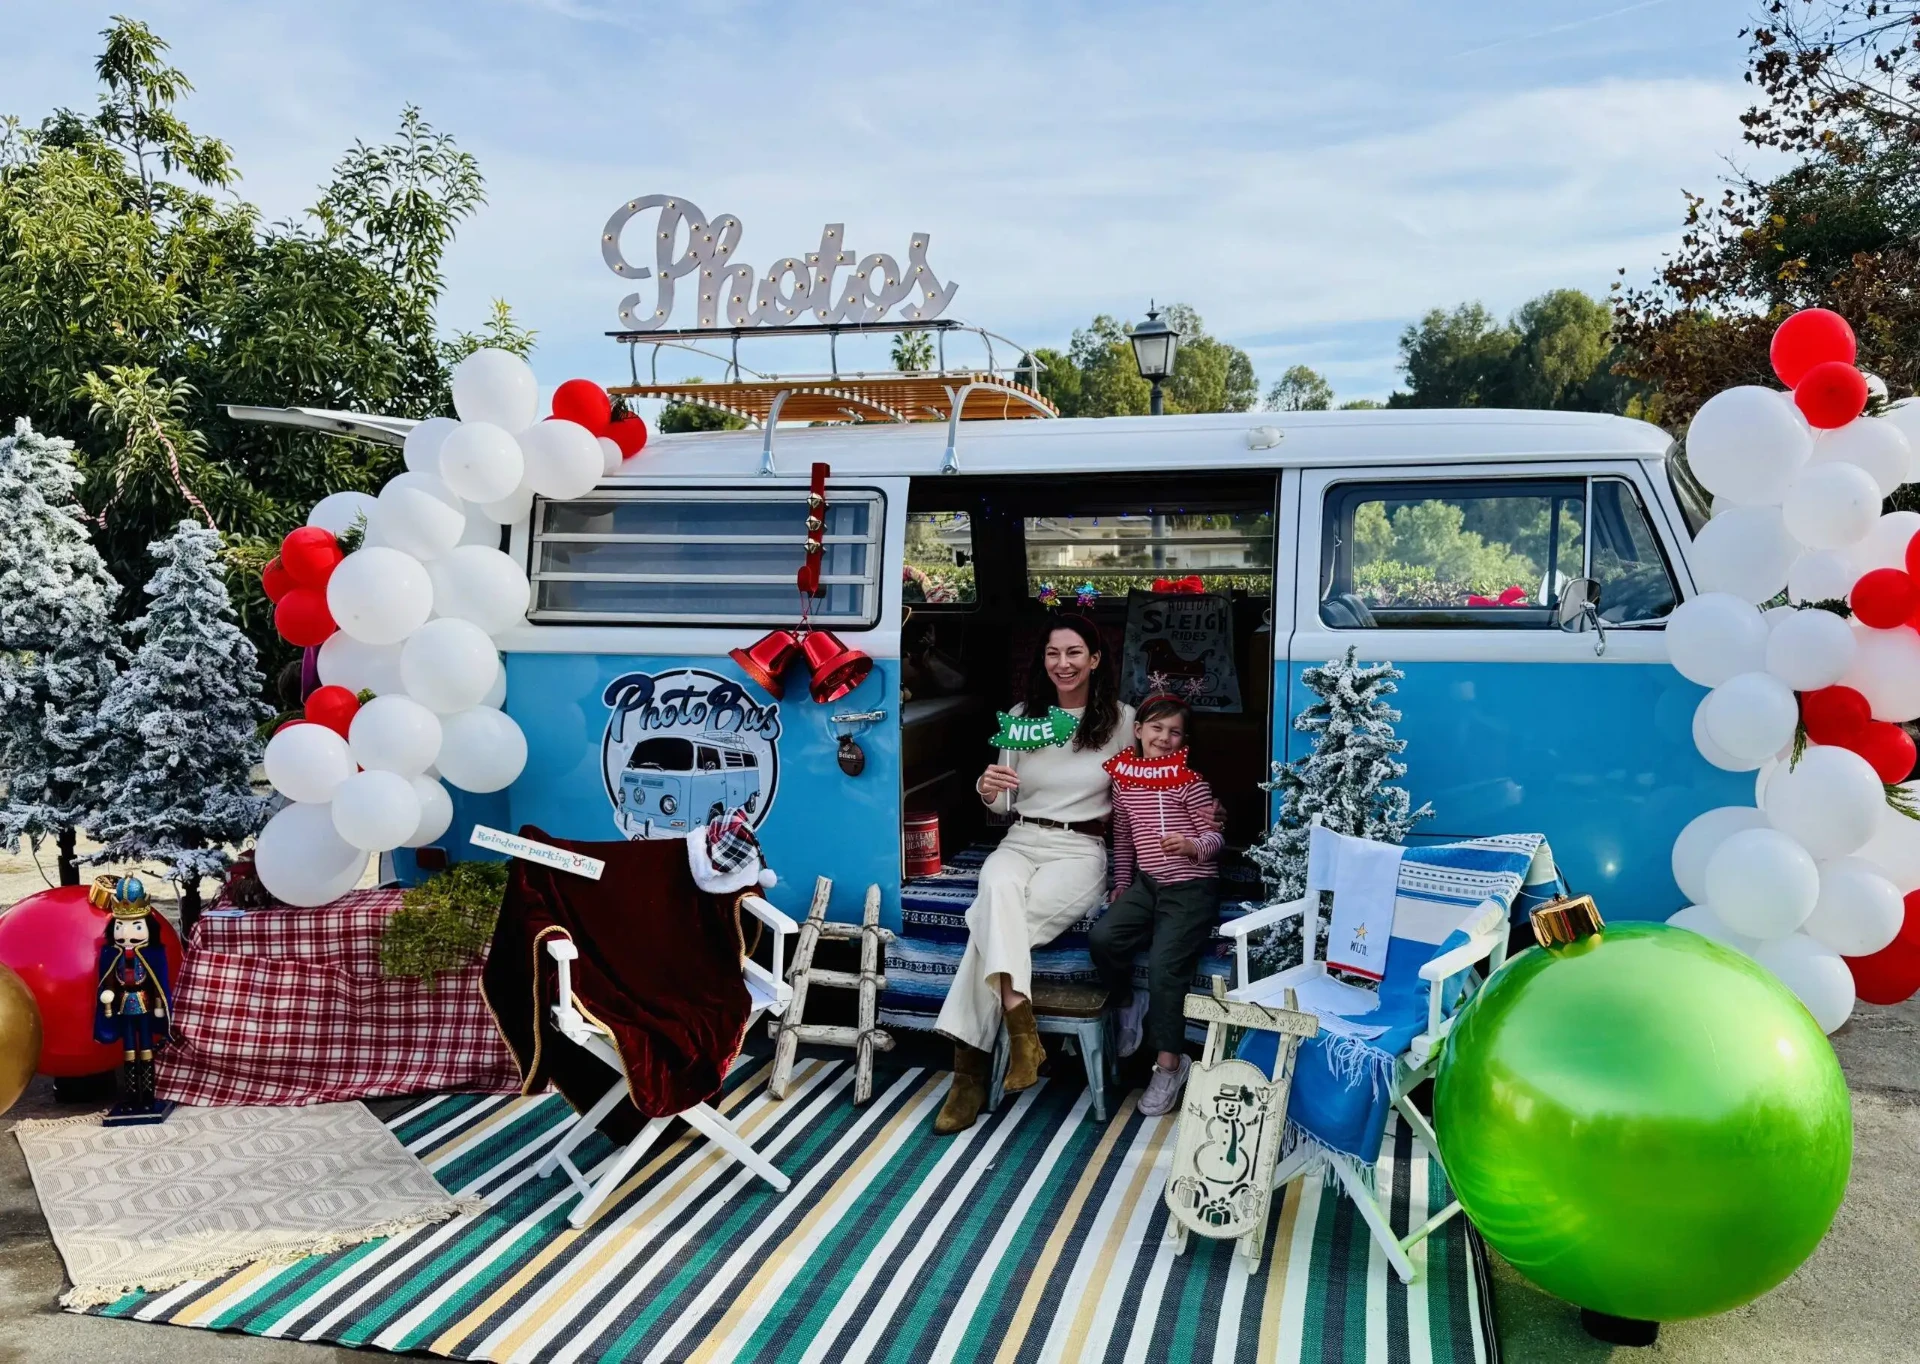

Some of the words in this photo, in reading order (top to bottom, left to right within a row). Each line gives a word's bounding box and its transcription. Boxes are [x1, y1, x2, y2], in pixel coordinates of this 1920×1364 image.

[601, 193, 959, 331] Photos
[1141, 606, 1228, 634] SLEIGH
[1171, 631, 1207, 641] RIDES
[1183, 696, 1219, 706] OCOA
[1008, 722, 1055, 742] NICE
[838, 751, 857, 760] Believe
[1114, 761, 1179, 779] NAUGHTY
[476, 830, 527, 851] Reindeer
[528, 846, 571, 868] parking
